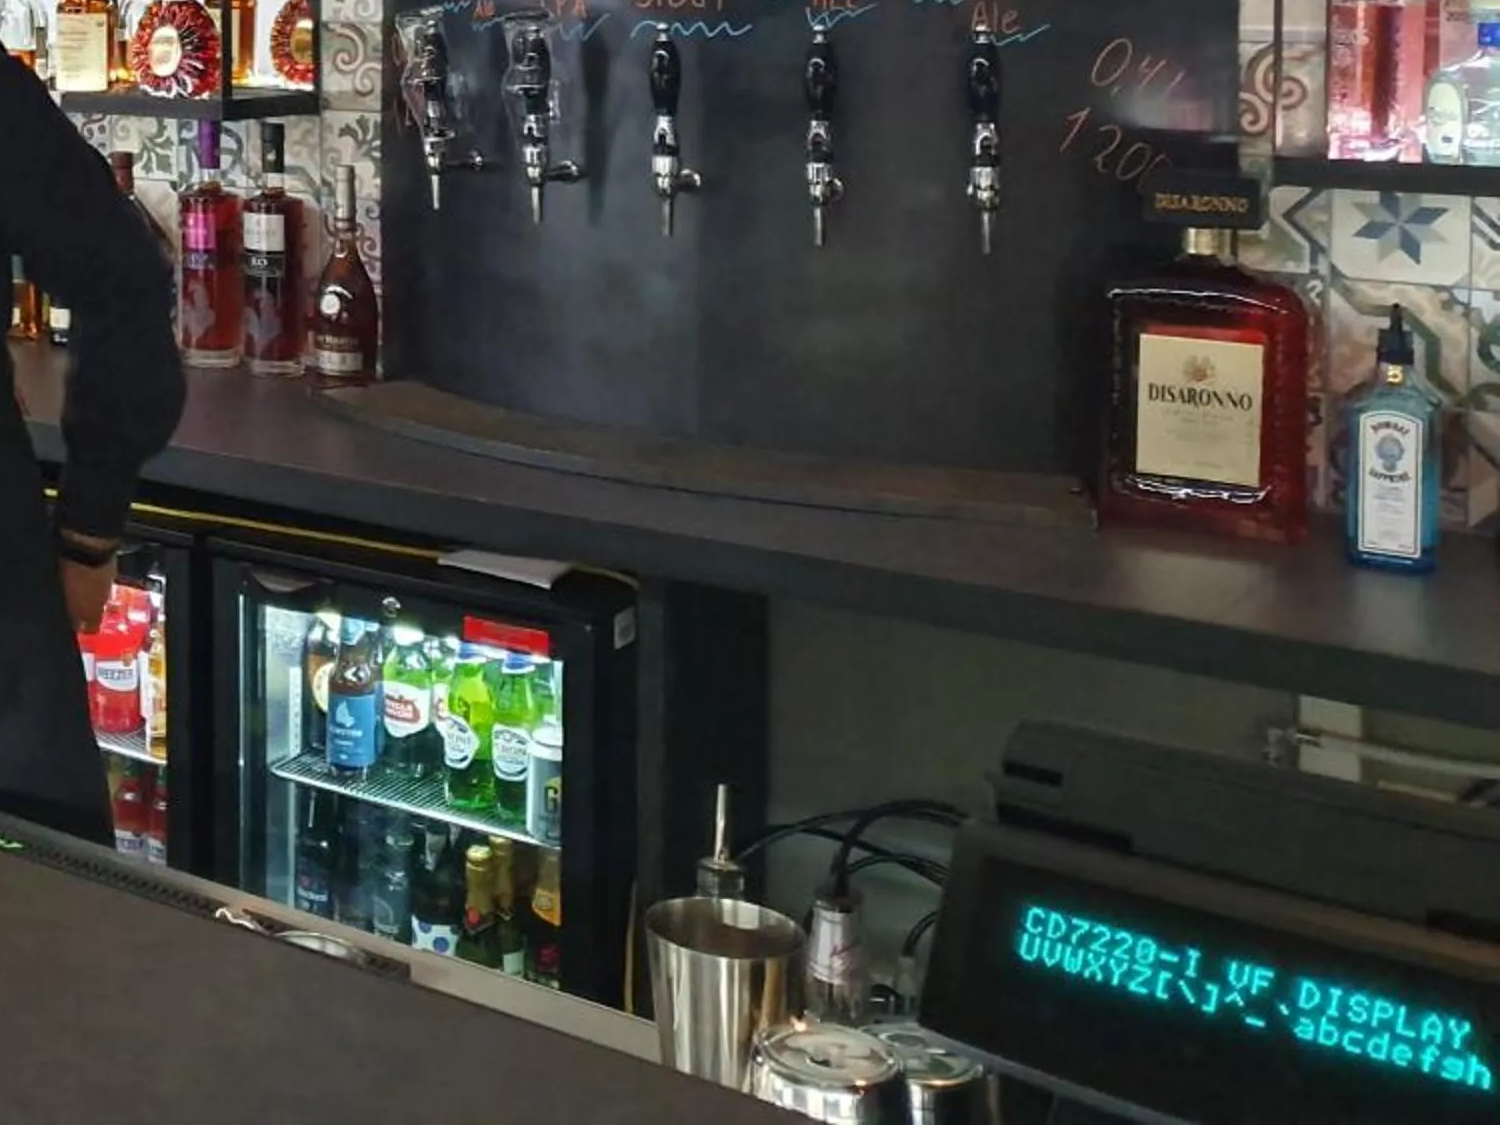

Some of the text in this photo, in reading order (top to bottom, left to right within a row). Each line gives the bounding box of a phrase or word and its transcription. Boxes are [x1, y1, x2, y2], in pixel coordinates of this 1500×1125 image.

[1148, 382, 1253, 411] DISARONNO
[1227, 960, 1275, 996] VF
[1298, 979, 1471, 1050] DISPLAY
